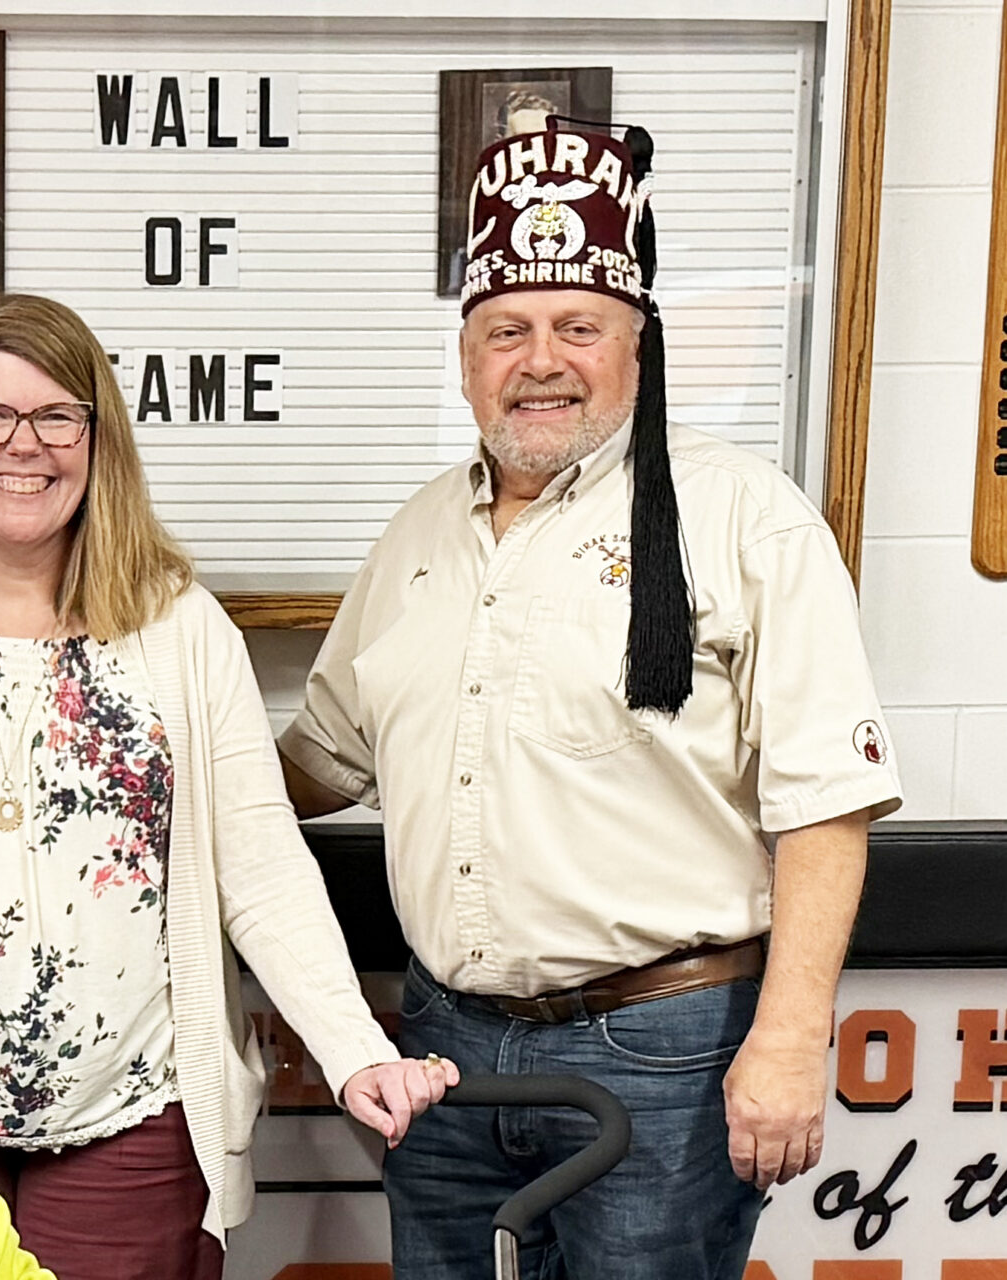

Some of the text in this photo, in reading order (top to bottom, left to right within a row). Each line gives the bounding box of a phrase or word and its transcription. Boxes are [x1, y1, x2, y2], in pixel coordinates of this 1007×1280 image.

[97, 75, 289, 147] WALL
[145, 217, 236, 286] OF
[503, 261, 596, 285] SHRINE
[107, 354, 280, 422] AME
[572, 534, 606, 559] BIRAK
[813, 1138, 918, 1251] of
